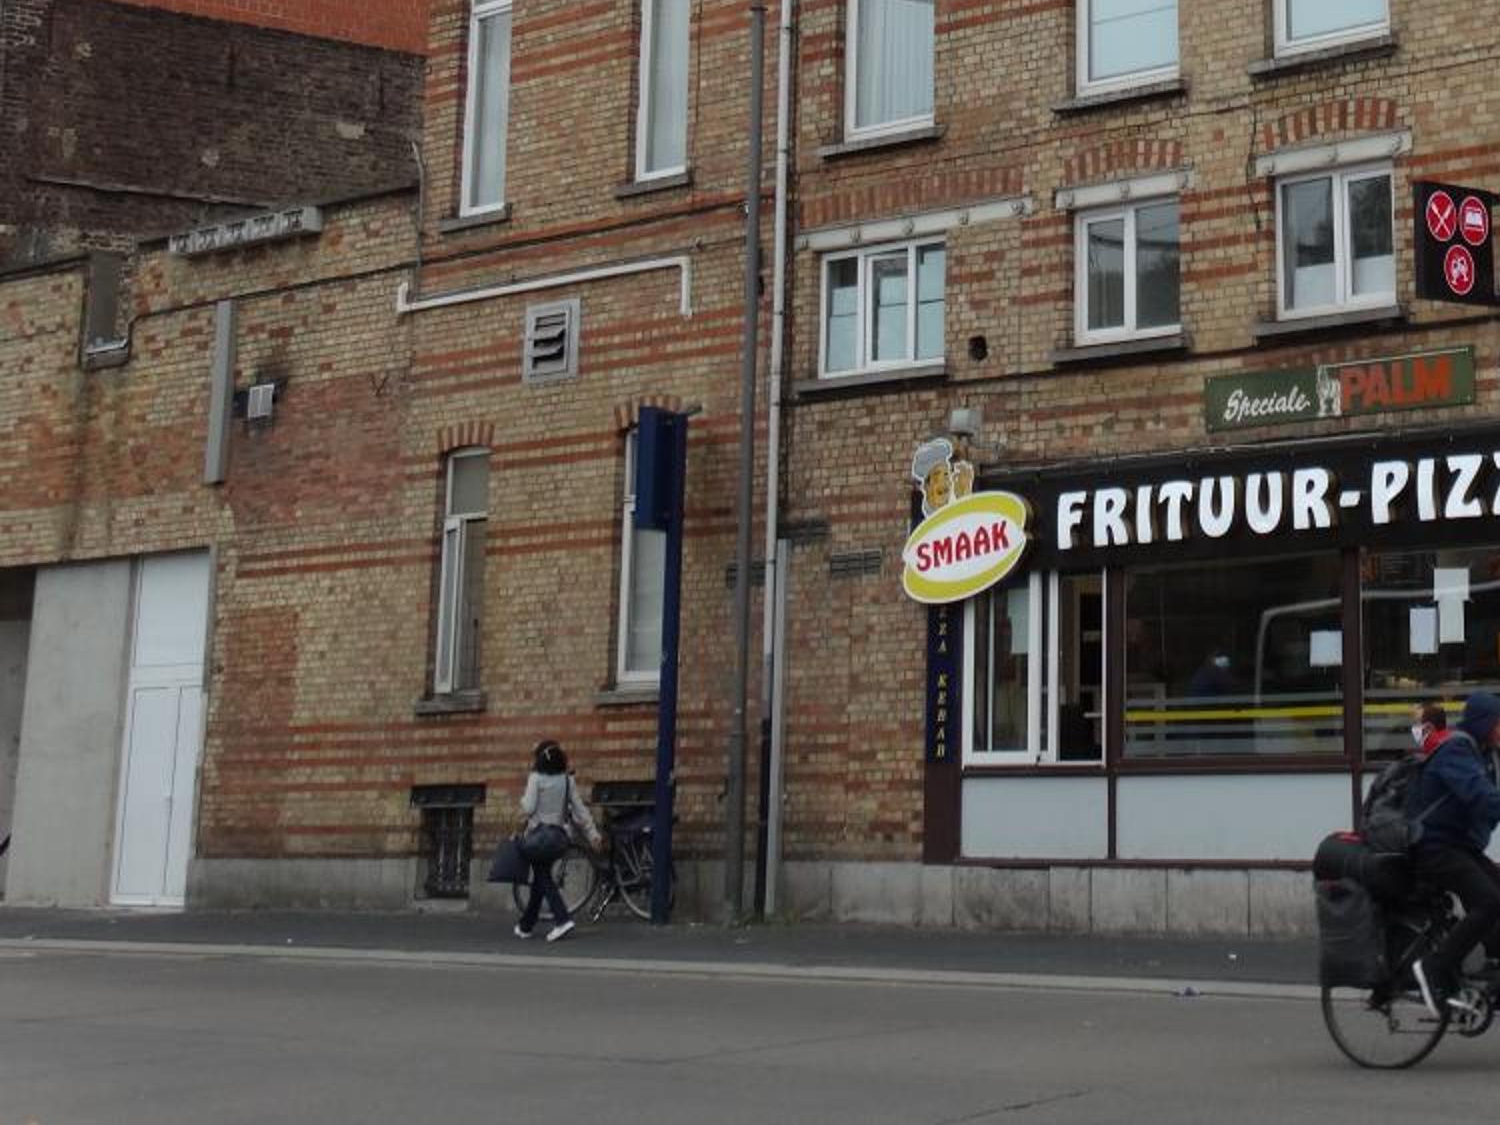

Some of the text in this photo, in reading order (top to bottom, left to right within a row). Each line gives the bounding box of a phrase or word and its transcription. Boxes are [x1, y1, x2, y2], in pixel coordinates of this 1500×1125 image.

[1223, 356, 1450, 422] Speciale PALM
[916, 520, 1009, 572] SMAAK
